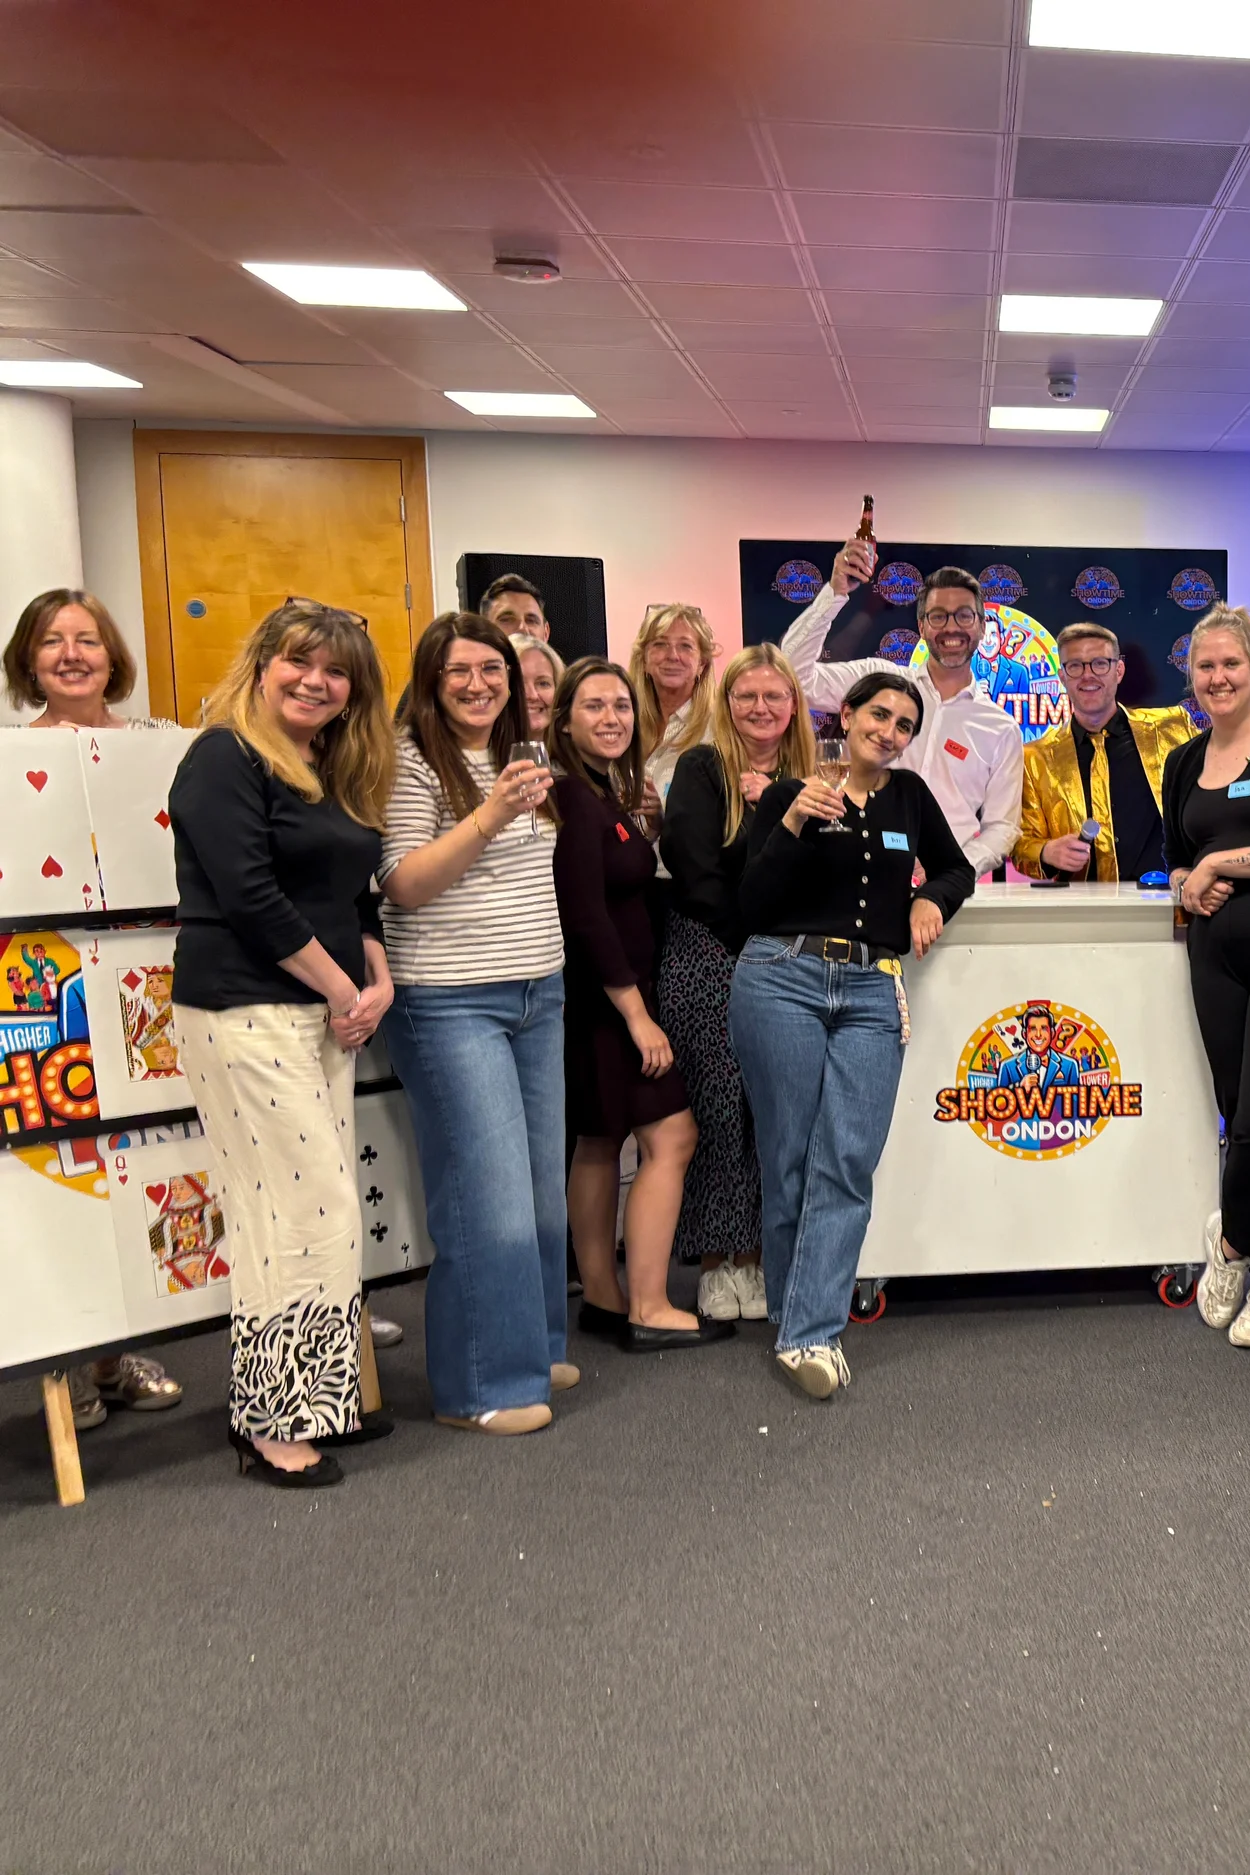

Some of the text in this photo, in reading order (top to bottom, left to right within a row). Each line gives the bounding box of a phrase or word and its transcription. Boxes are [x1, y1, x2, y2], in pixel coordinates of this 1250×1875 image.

[1070, 588, 1125, 598] SHOWTIME
[1166, 590, 1220, 600] SHOWTIME
[934, 1084, 1142, 1121] SHOWTIME
[986, 1119, 1093, 1142] LONDON
